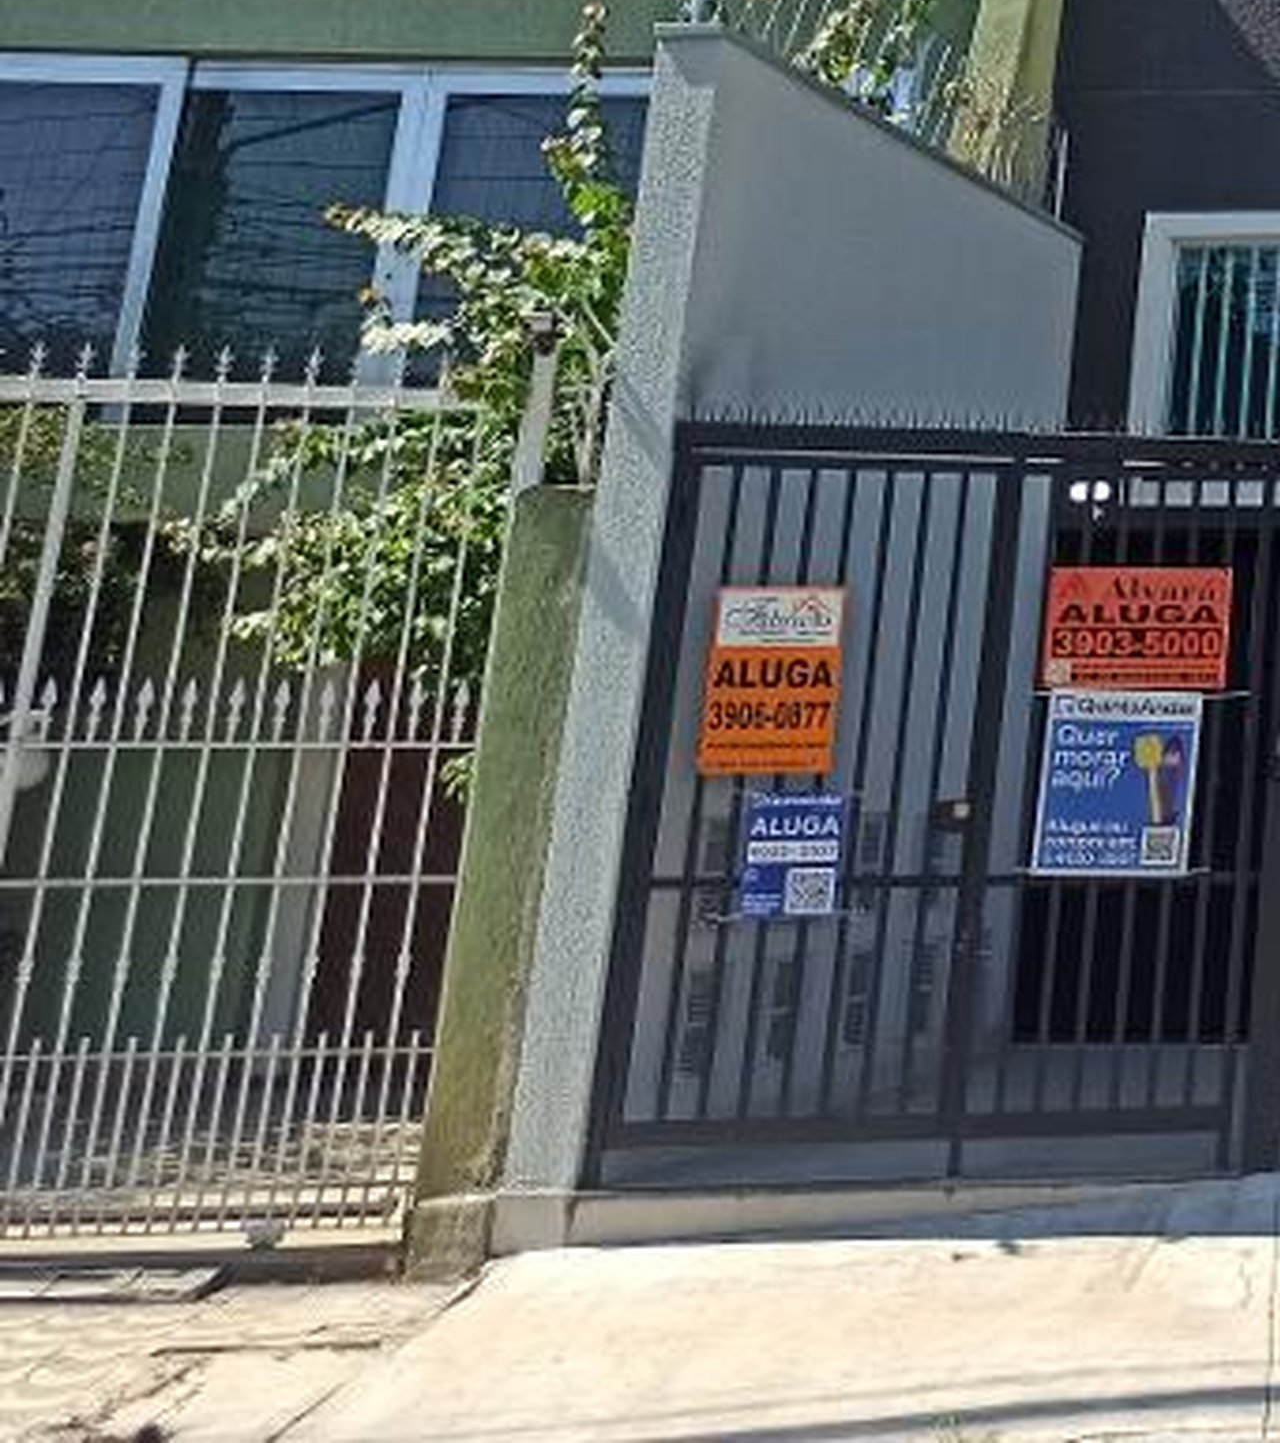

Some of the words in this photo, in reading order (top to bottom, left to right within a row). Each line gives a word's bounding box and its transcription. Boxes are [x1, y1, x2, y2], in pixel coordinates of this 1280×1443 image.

[1058, 604, 1219, 624] ALUGA
[1054, 630, 1219, 655] 3903-5000
[713, 660, 832, 689] ALUGA
[1057, 724, 1120, 745] Quer
[1054, 750, 1130, 768] morar
[750, 815, 840, 836] ALUGA
